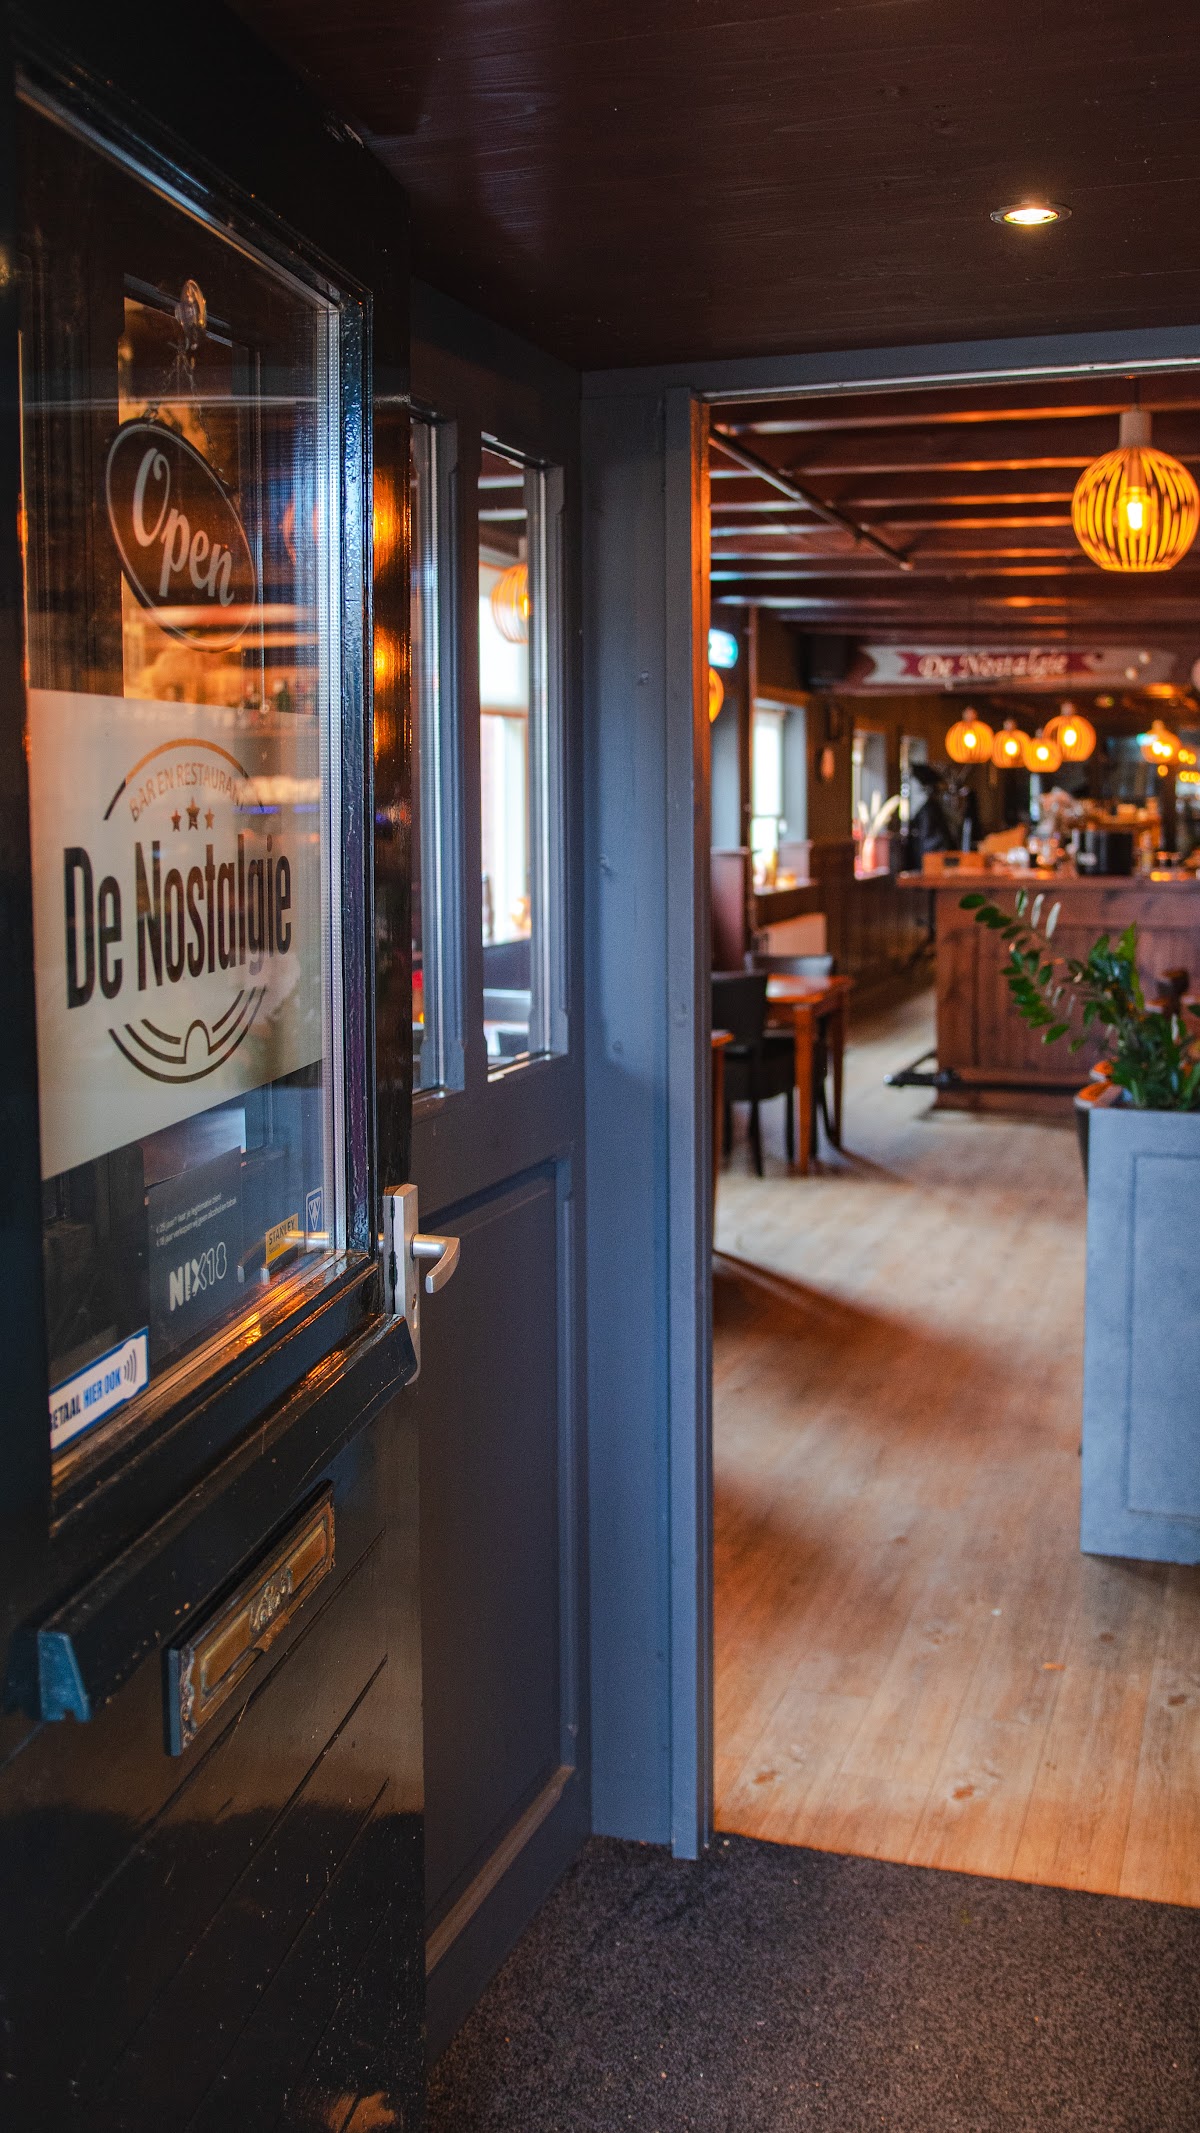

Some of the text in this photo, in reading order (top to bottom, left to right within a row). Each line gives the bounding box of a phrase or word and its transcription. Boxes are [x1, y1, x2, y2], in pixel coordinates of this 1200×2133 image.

[132, 447, 235, 608] Open
[917, 648, 1069, 681] De Nostalgie
[128, 778, 157, 822] BAR
[156, 767, 175, 795] EN
[63, 833, 292, 1010] De Nostalgie
[169, 1241, 227, 1312] NIX18
[83, 1380, 103, 1410] HIER
[104, 1366, 122, 1395] OOK
